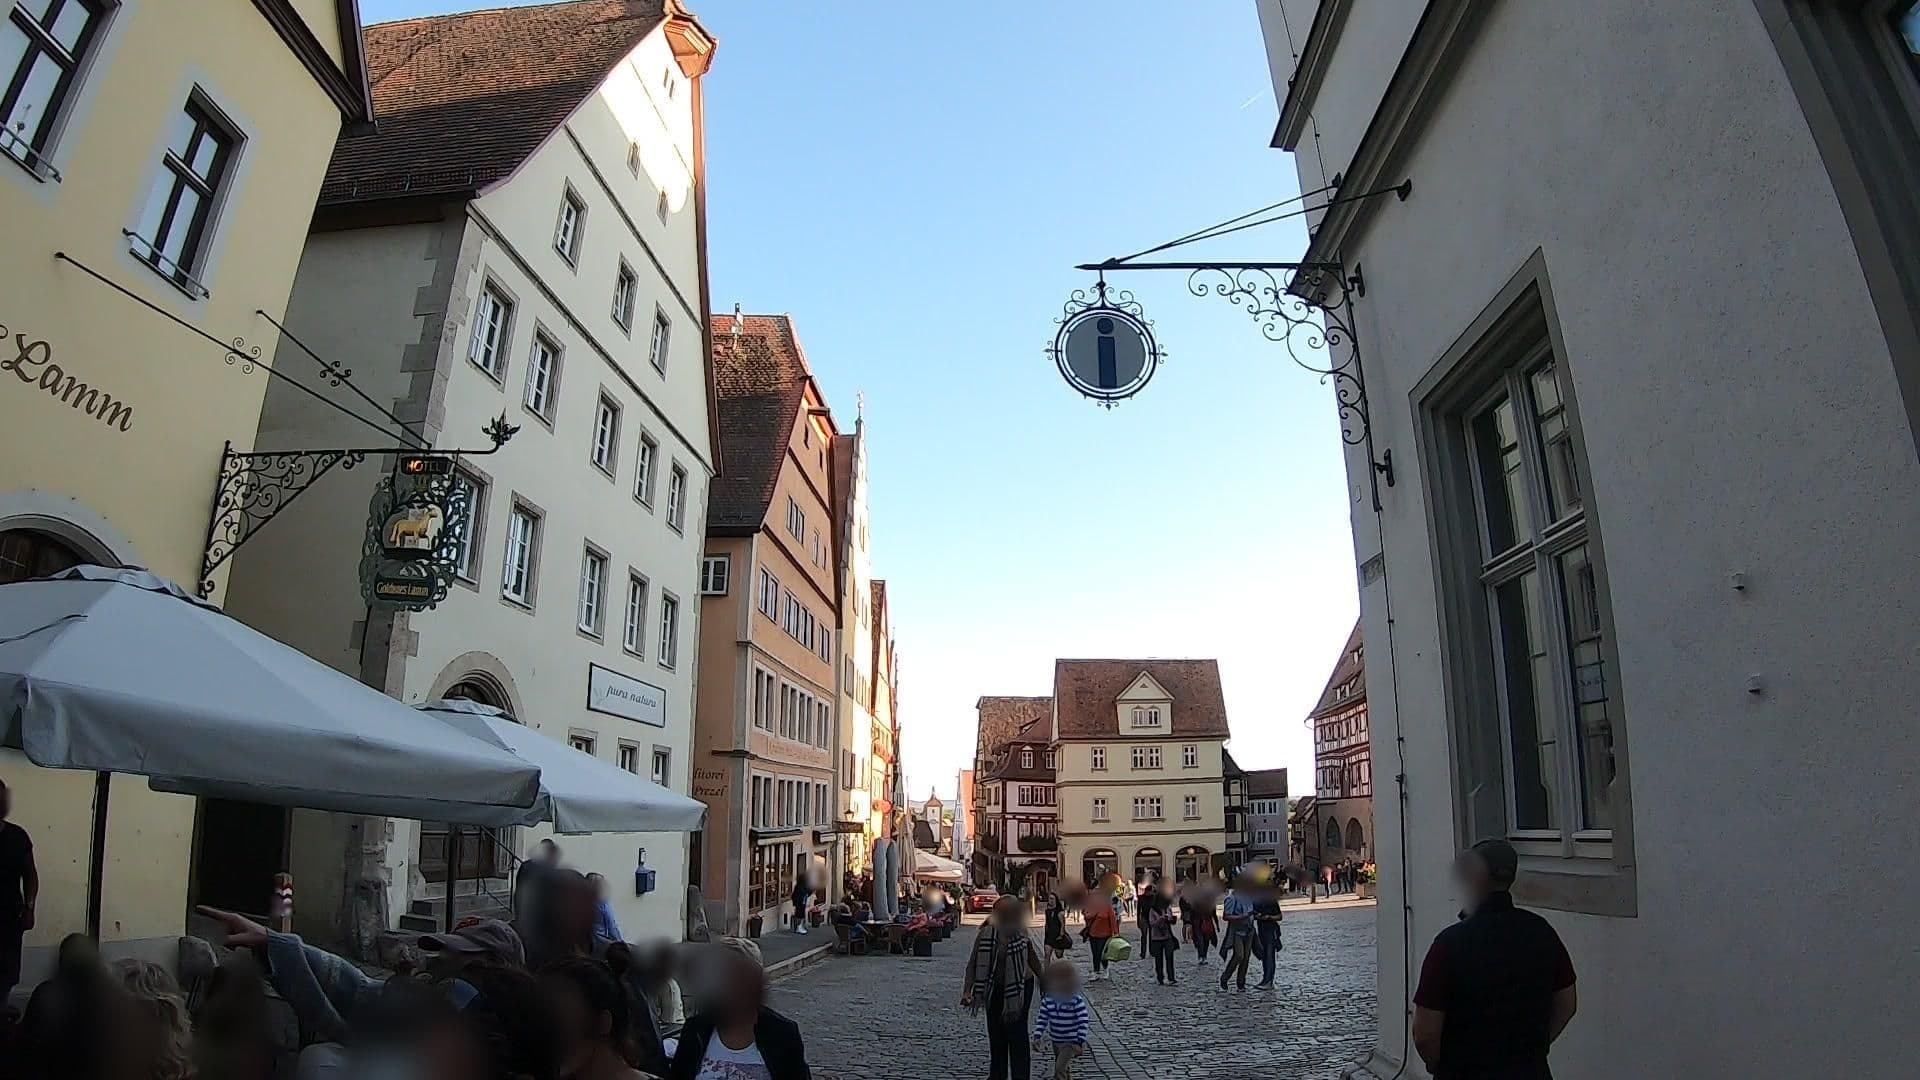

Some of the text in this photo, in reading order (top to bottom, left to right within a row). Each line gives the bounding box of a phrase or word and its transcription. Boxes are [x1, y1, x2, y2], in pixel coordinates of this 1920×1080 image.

[1, 333, 132, 432] Lamm
[406, 460, 441, 472] HOTEL
[605, 685, 657, 708] pura natura
